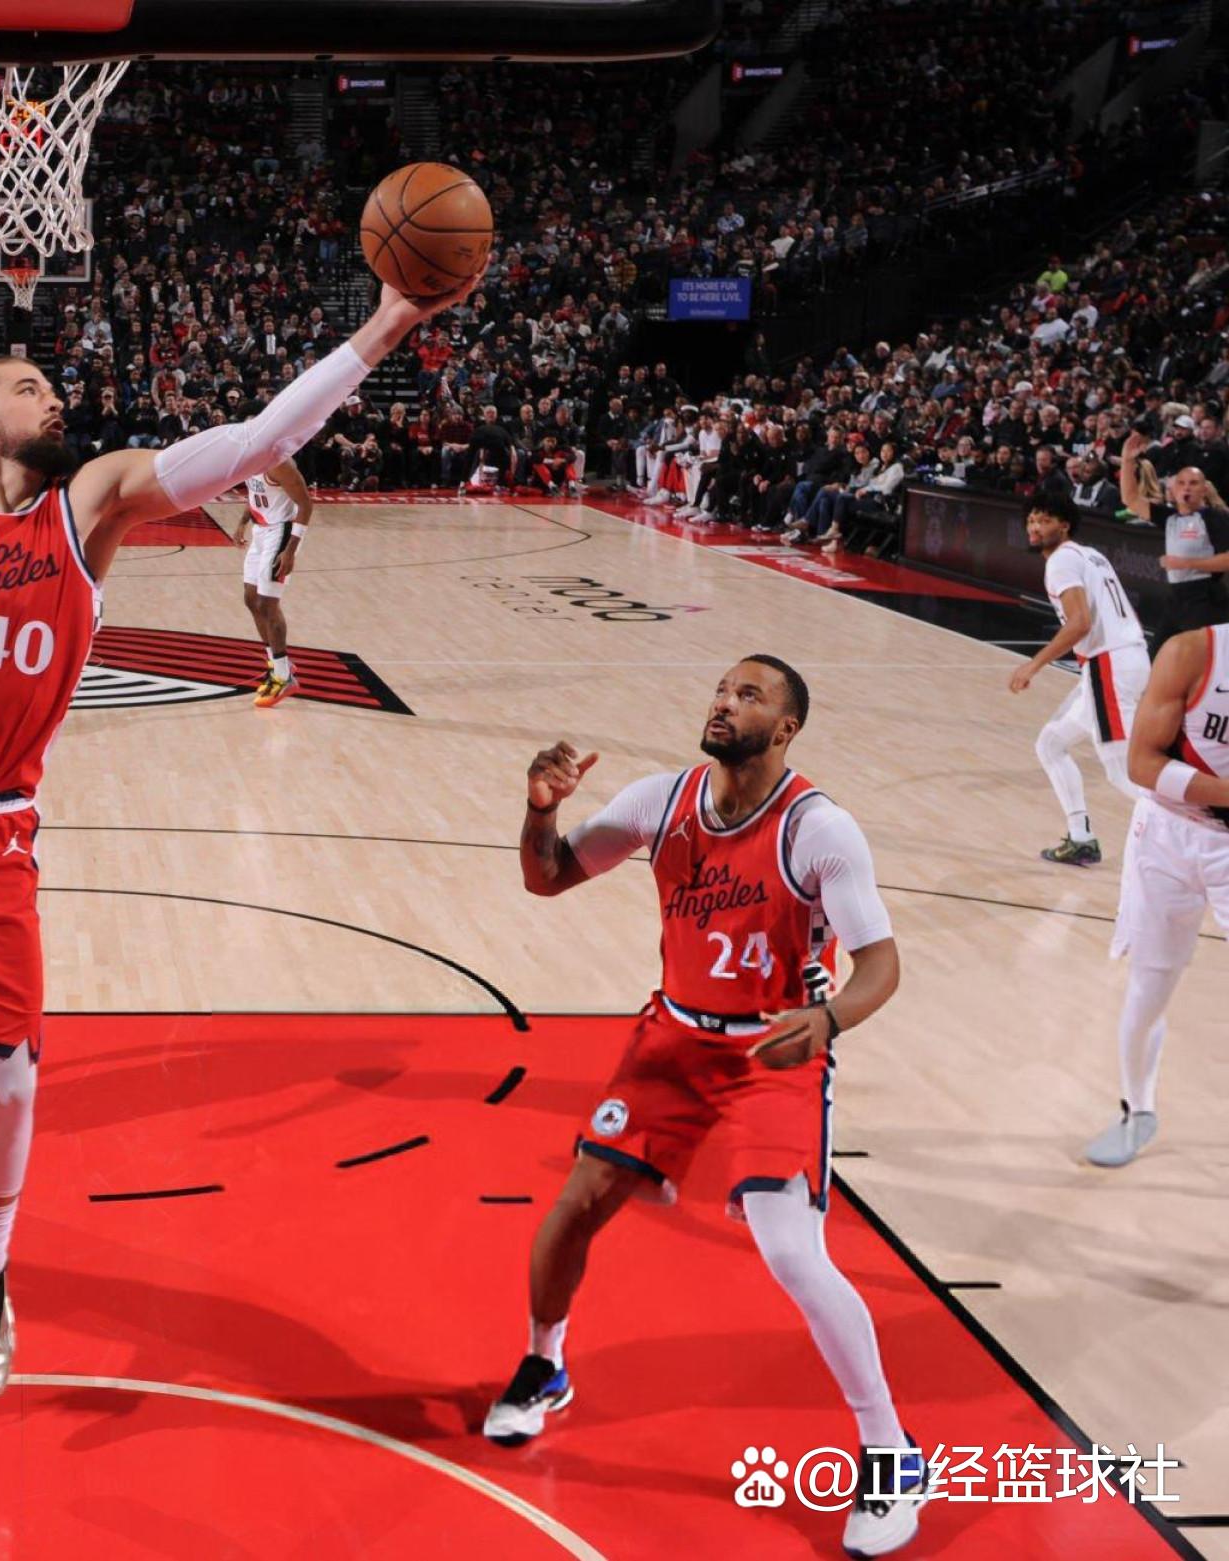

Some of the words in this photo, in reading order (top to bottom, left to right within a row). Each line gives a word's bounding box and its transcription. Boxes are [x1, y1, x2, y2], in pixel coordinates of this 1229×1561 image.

[677, 292, 688, 302] TO
[689, 292, 698, 302] BE
[700, 292, 720, 302] HERE
[696, 281, 718, 291] MORE
[720, 281, 738, 291] FUN
[1103, 577, 1127, 619] 17
[686, 854, 732, 891] Los
[665, 876, 769, 929] Angeles
[708, 931, 774, 980] 24
